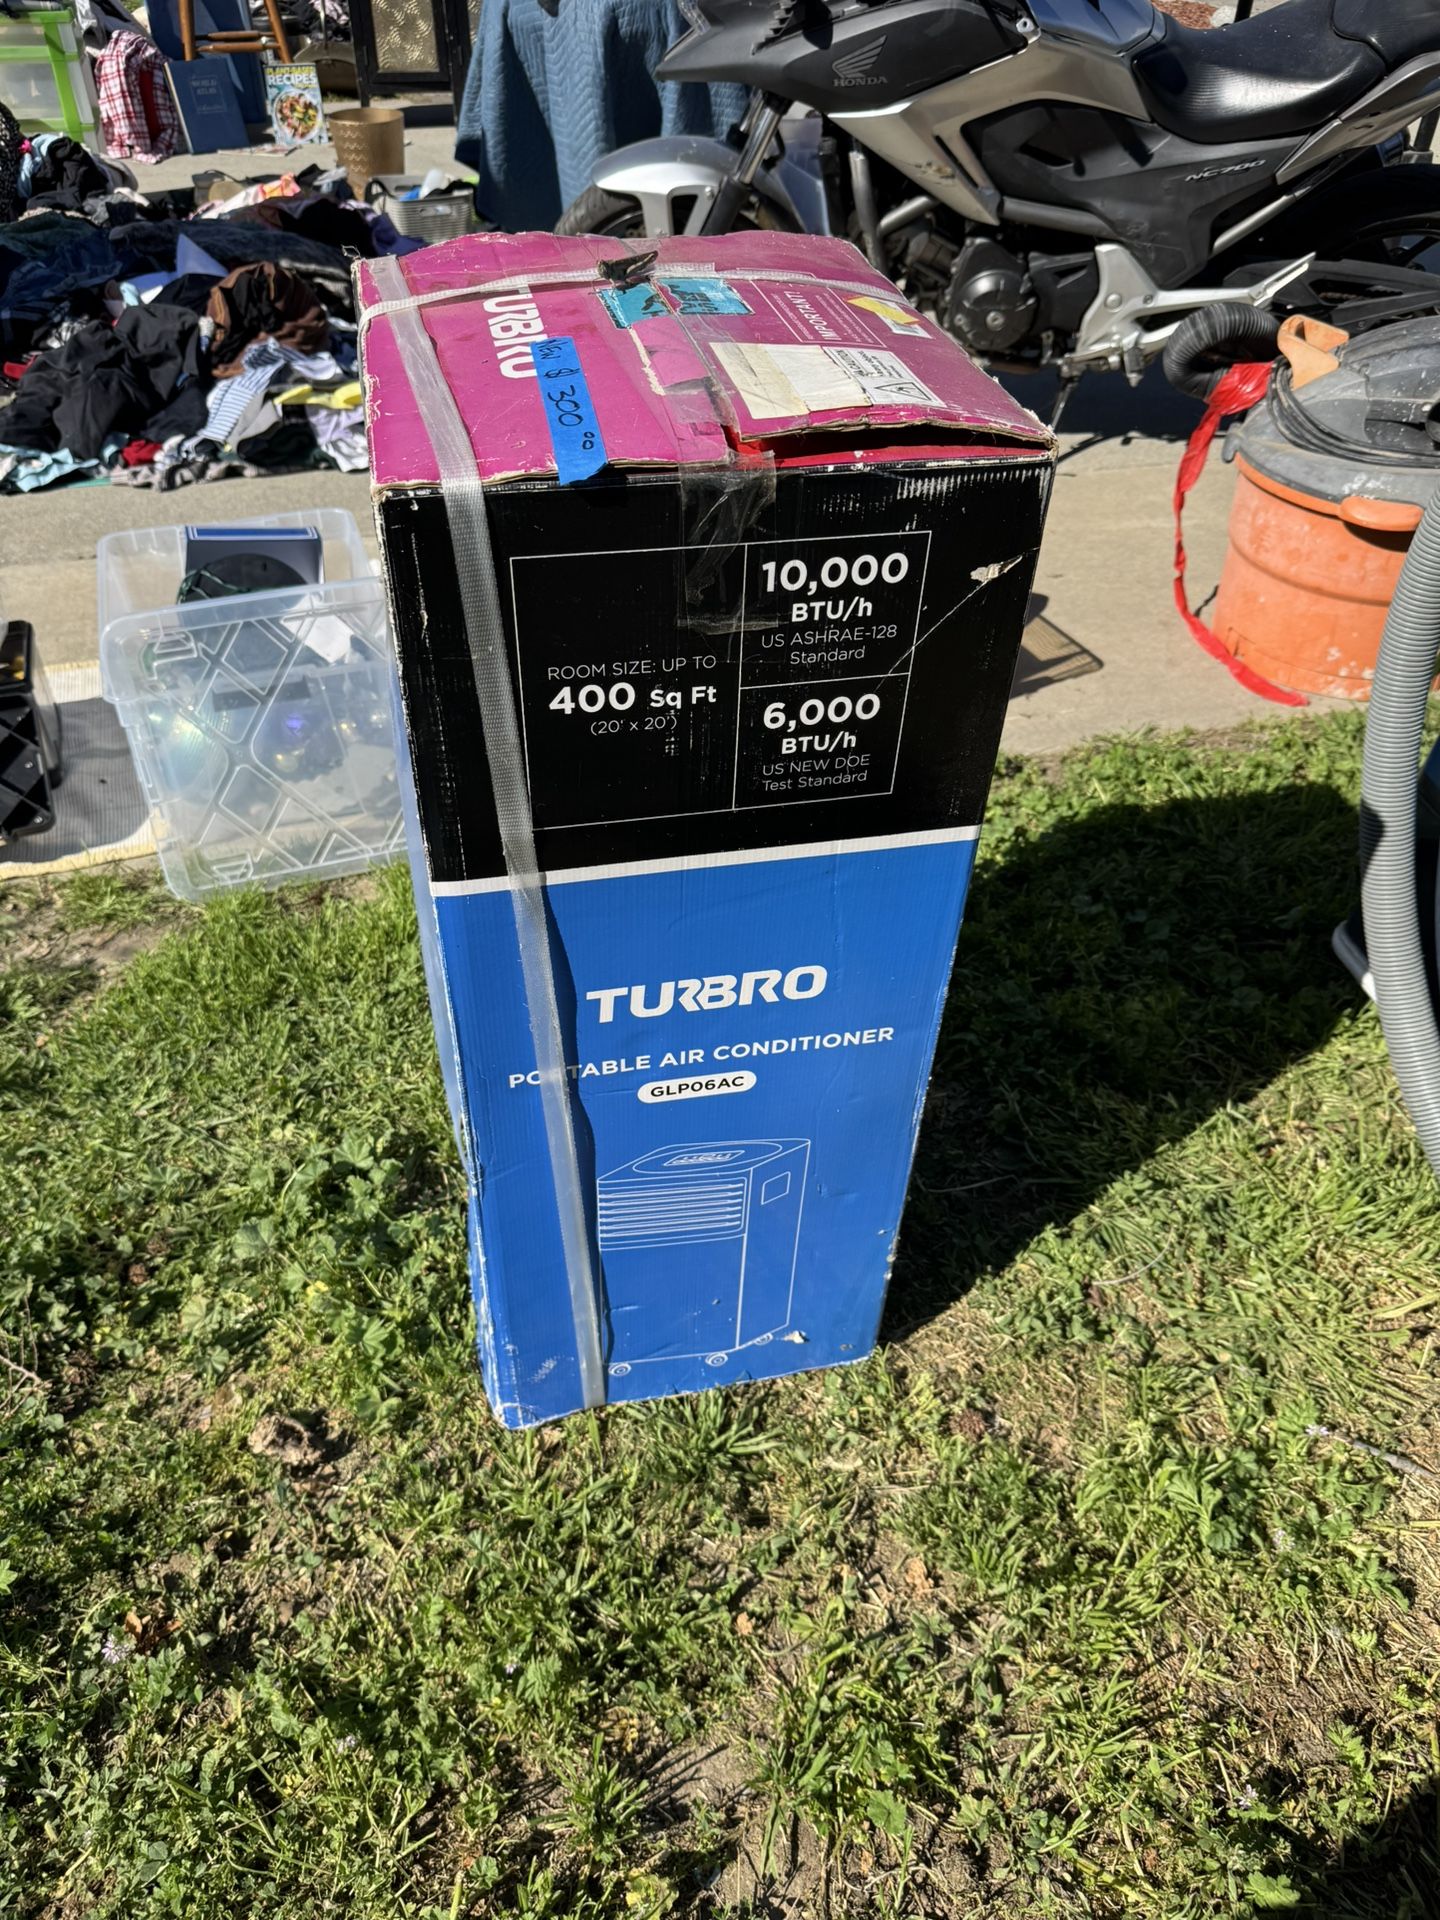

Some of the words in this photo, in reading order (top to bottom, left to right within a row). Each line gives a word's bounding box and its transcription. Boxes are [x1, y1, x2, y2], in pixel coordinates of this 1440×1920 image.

[269, 74, 318, 85] RECIPES
[833, 76, 888, 87] HONDA
[1185, 159, 1266, 182] NC700
[784, 291, 842, 340] IMPORTANT!
[548, 384, 584, 427] 300
[762, 552, 909, 596] 10,000
[791, 596, 873, 622] BTU/h
[761, 633, 785, 648] US
[790, 624, 897, 646] ASHRAE-128
[790, 645, 865, 665] Standard
[547, 663, 606, 681] ROOM
[612, 660, 656, 676] SIZE:
[662, 657, 687, 672] UP
[692, 655, 717, 670] TO
[549, 681, 636, 715] 400
[650, 688, 682, 709] Sq
[692, 685, 717, 705] Ft
[763, 693, 881, 733] 6,000
[590, 719, 624, 736] (20'
[629, 721, 639, 732] x
[644, 715, 677, 731] 20')
[781, 730, 857, 754] BTU/h
[762, 763, 784, 776] US
[790, 758, 830, 773] NEW
[835, 754, 871, 769] DOE
[762, 779, 793, 792] Test
[798, 769, 868, 788] Standard
[586, 964, 828, 1024] TURBRO
[508, 1055, 651, 1088] POTABLE
[659, 1048, 705, 1067] AIR
[713, 1027, 894, 1060] CONDITIONER
[650, 1075, 745, 1098] GLP06AC
